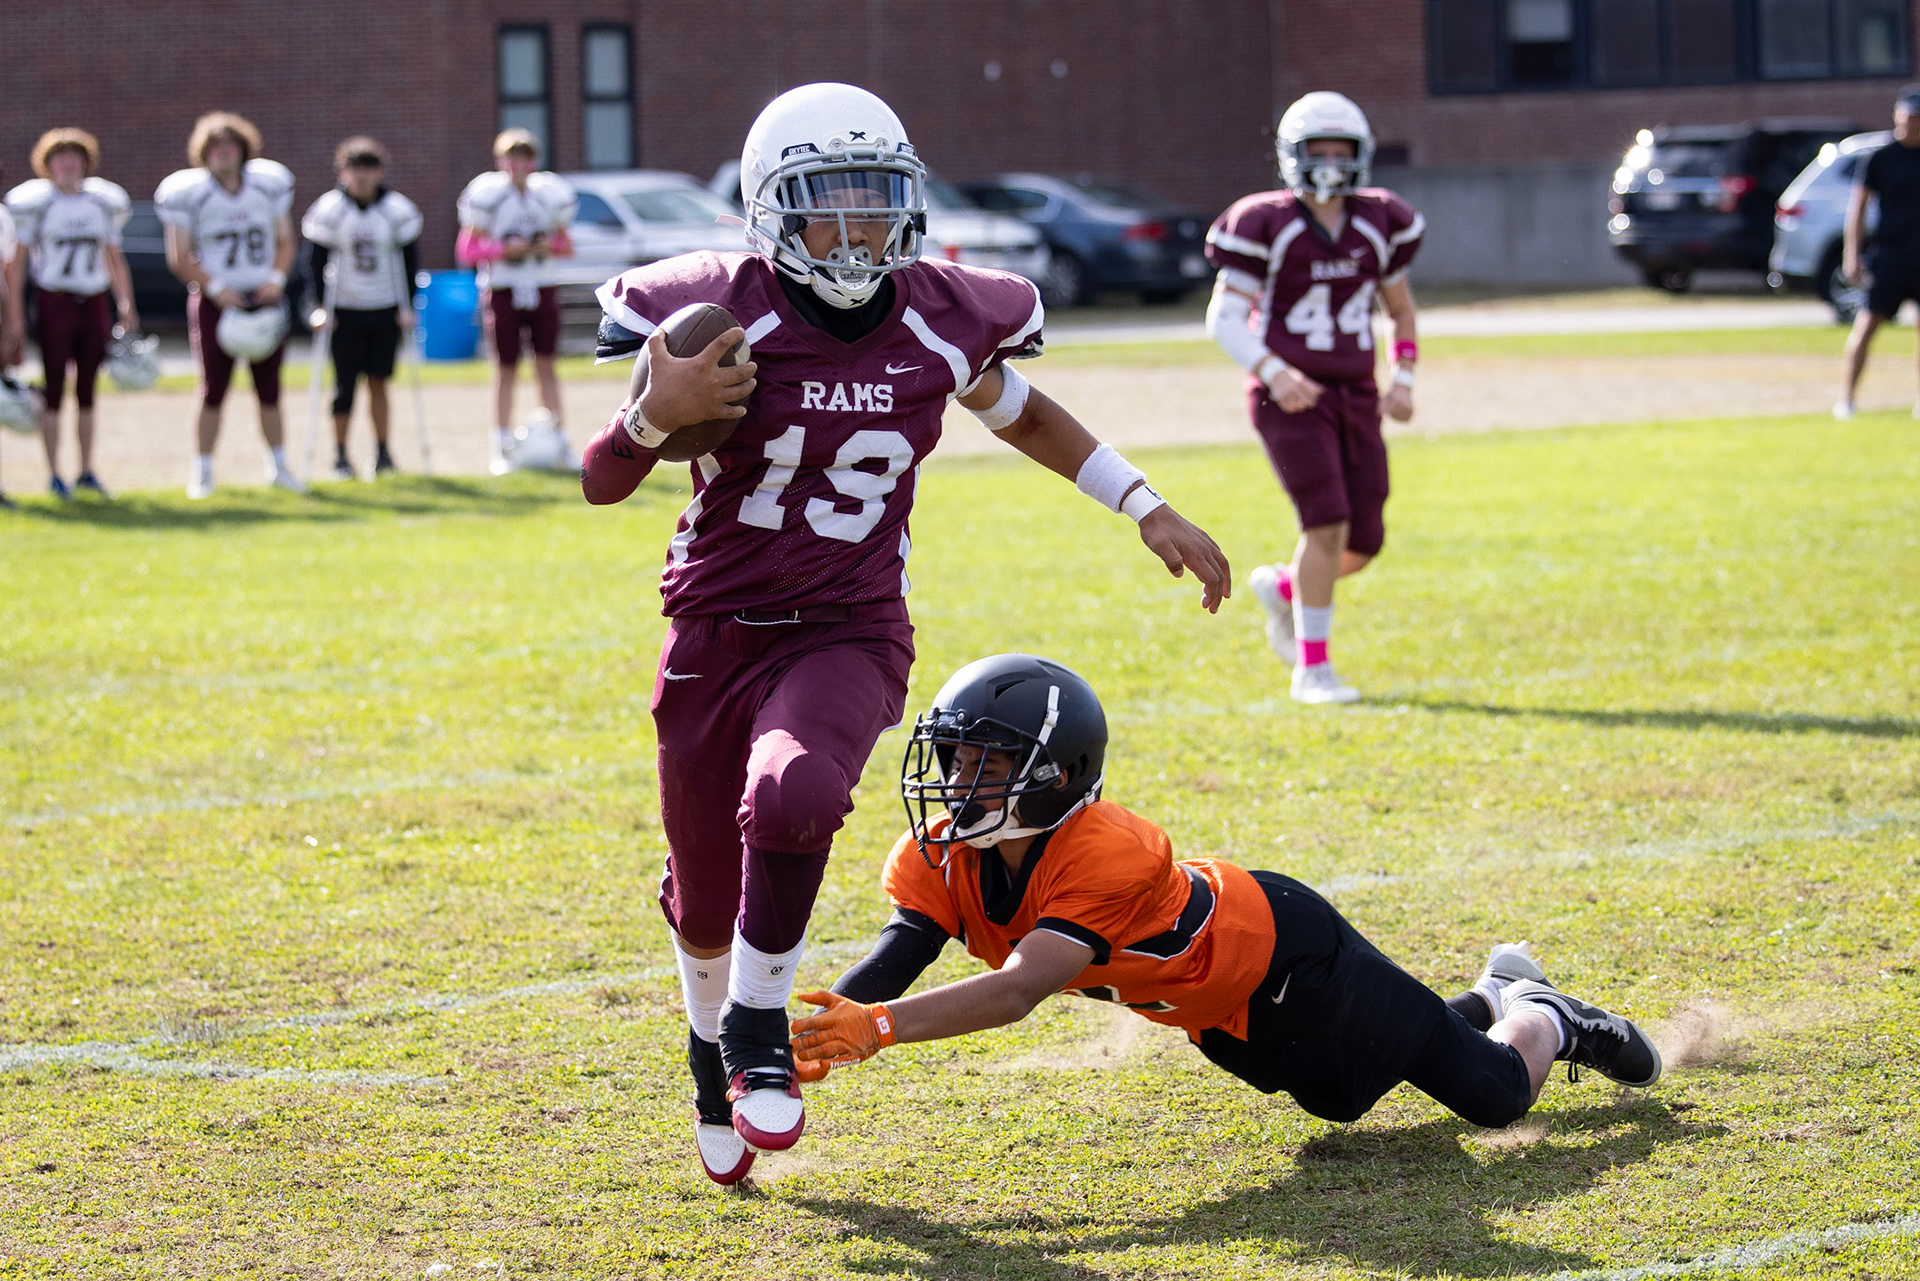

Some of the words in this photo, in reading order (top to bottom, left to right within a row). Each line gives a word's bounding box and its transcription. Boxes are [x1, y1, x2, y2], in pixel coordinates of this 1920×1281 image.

[214, 226, 266, 268] 78
[1285, 280, 1374, 352] 44
[801, 381, 894, 413] RAMS
[737, 425, 915, 544] 19
